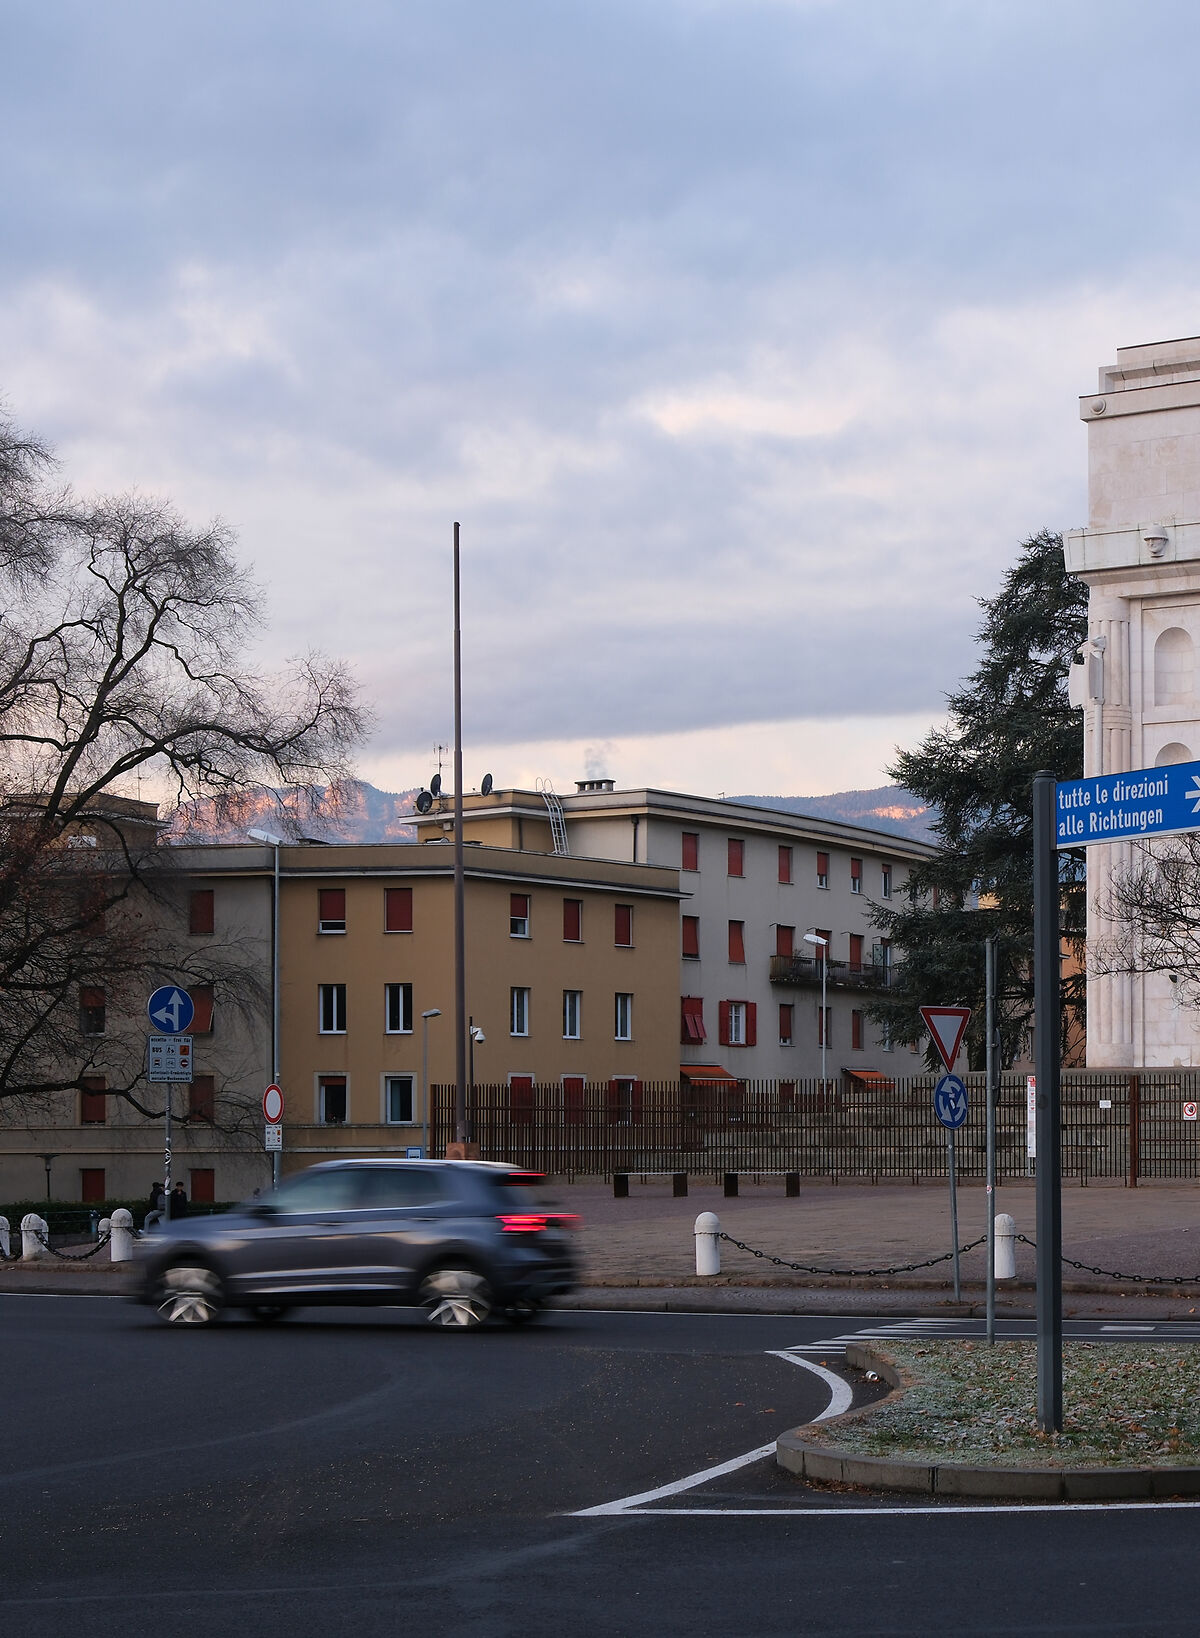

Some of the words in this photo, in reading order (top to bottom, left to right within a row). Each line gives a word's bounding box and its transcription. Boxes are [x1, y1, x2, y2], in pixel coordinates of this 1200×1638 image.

[1058, 787, 1091, 810] tutte
[1095, 783, 1108, 805] le
[1112, 773, 1169, 802] direzioni
[1058, 814, 1084, 837] alle
[1089, 808, 1163, 832] Richtungen
